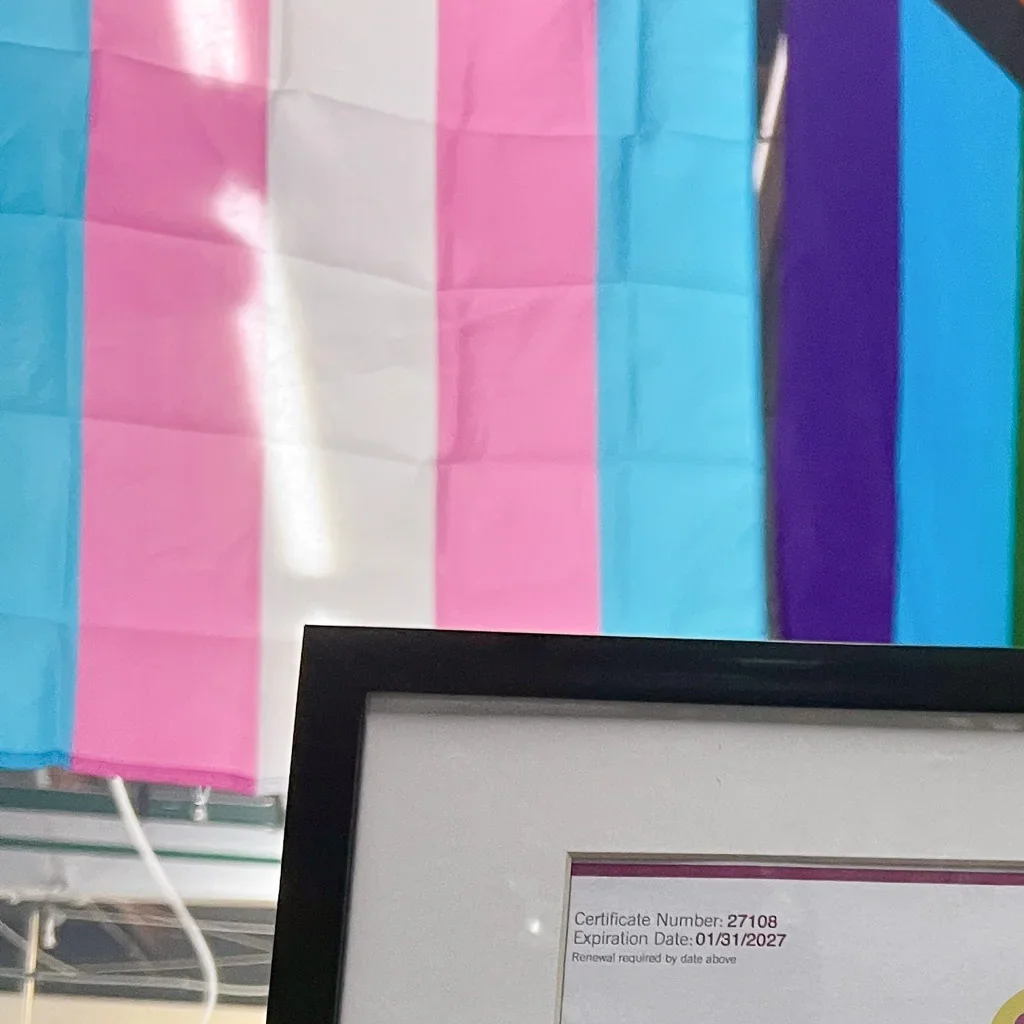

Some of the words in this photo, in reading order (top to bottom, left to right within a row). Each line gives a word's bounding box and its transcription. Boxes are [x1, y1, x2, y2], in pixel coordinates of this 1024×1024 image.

[575, 911, 651, 927] Certificate
[656, 913, 723, 928] Number:
[727, 914, 778, 929] 27108
[574, 931, 648, 947] Expiration
[654, 932, 693, 946] Date:
[695, 933, 787, 947] 01/31/2027
[572, 952, 616, 962] Renewal
[619, 953, 662, 964] required
[665, 953, 677, 965] by
[680, 954, 703, 964] date
[706, 954, 737, 964] above
